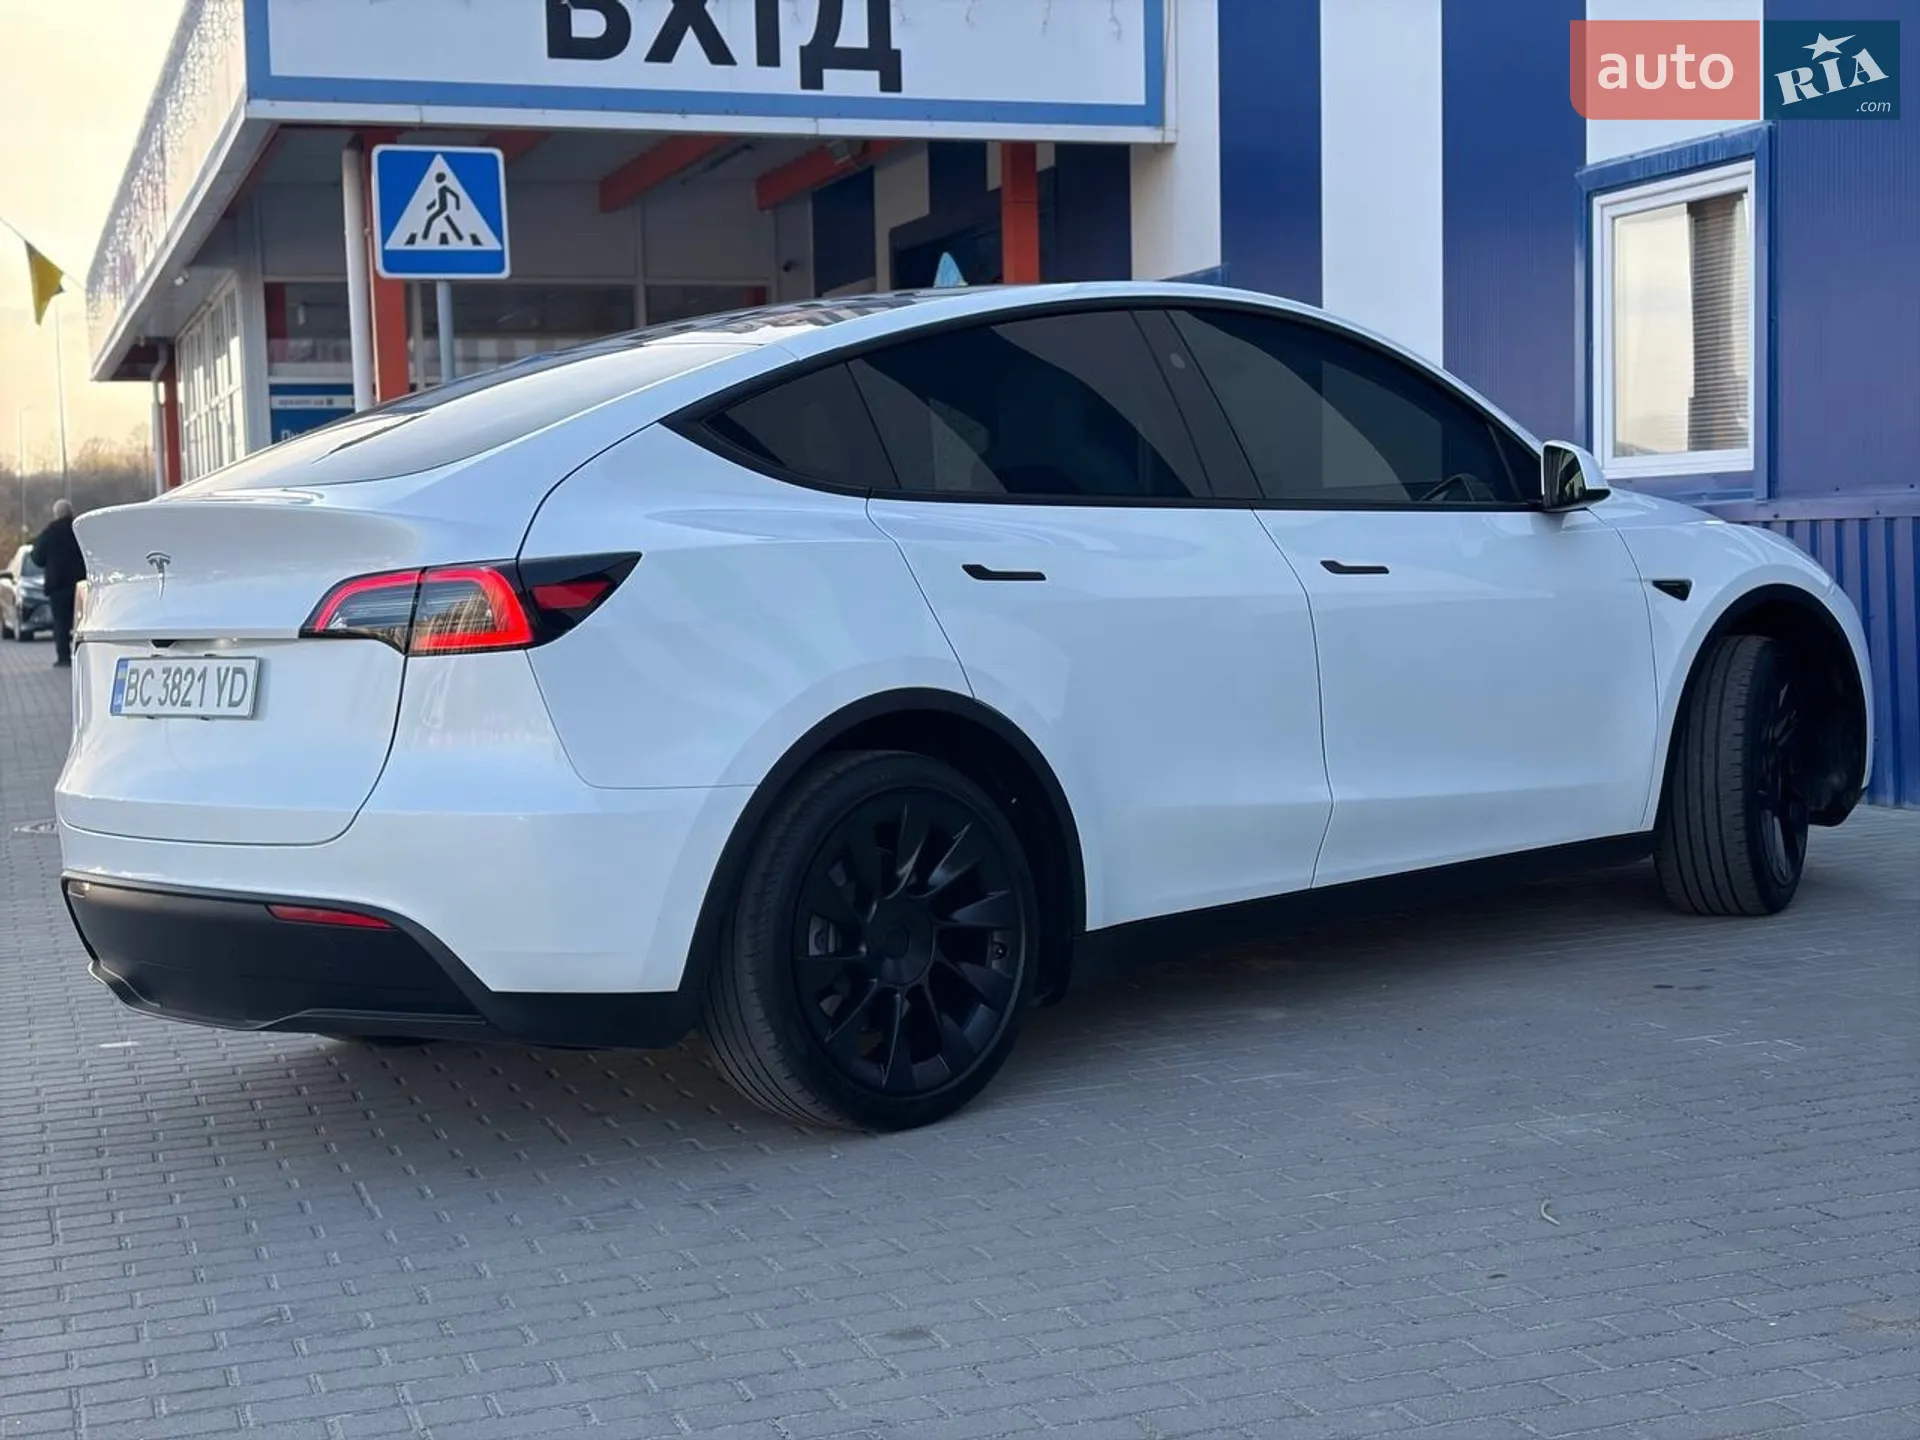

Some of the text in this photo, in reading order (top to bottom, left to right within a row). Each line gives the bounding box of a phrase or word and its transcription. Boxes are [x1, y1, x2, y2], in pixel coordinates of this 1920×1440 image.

[124, 666, 248, 708] BC 3821 YD
